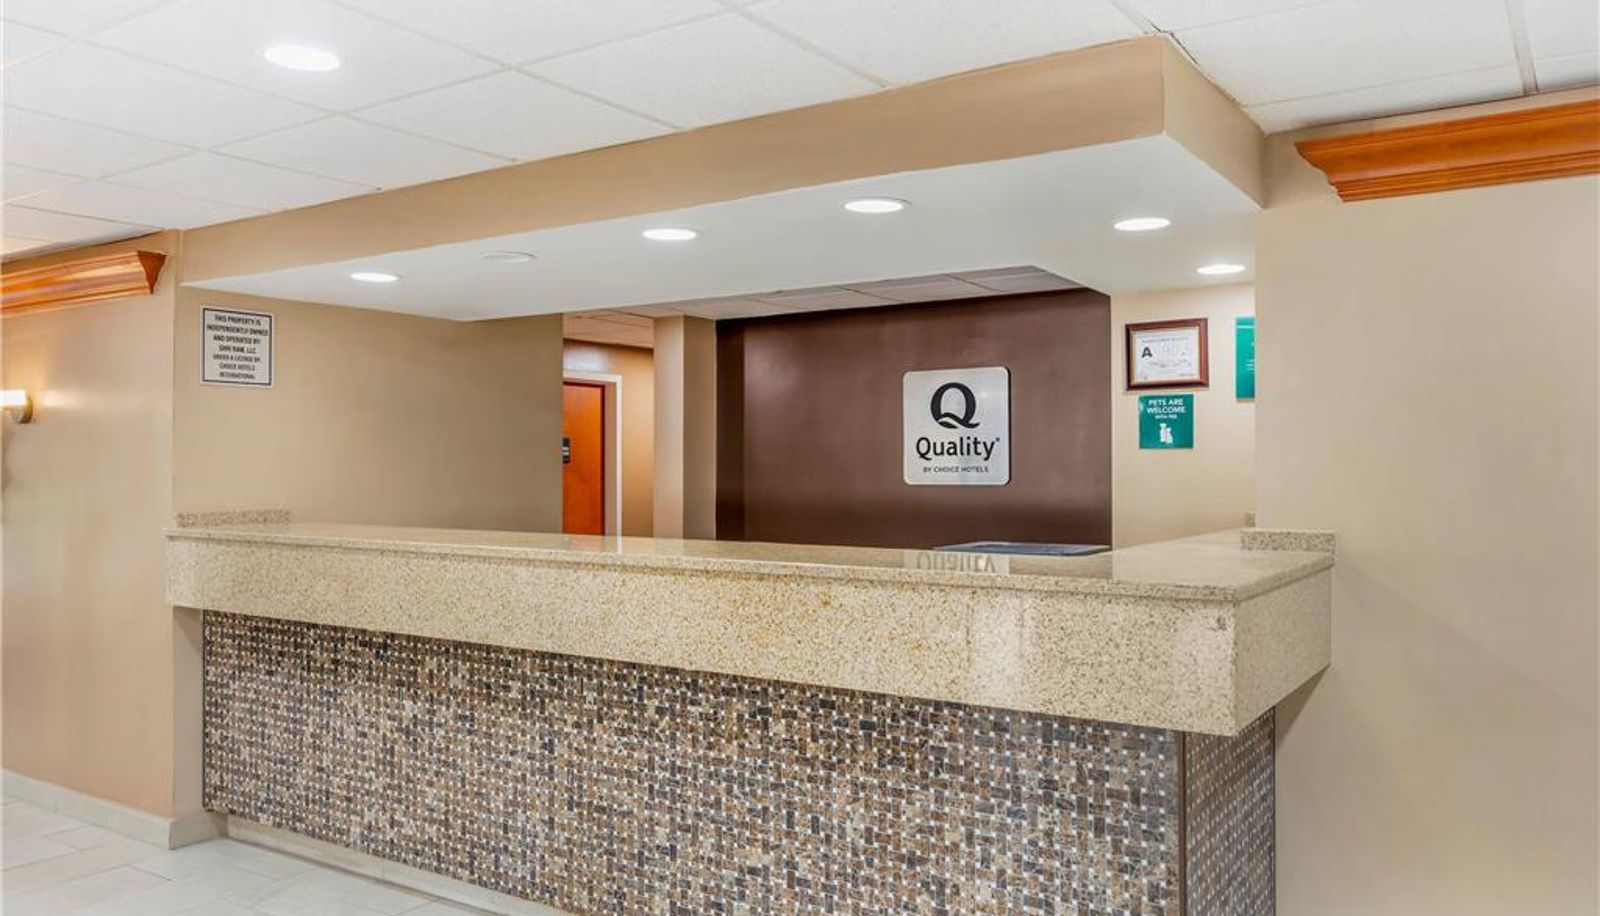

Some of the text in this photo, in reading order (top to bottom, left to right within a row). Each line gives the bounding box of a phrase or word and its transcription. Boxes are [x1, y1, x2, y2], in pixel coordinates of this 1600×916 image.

[227, 316, 255, 324] PROPERTY
[213, 334, 224, 342] AND
[1141, 346, 1153, 358] A
[930, 382, 980, 429] Q
[1168, 398, 1184, 406] ARE
[1147, 406, 1186, 414] WELCOME
[933, 465, 960, 473] CHOICE
[960, 465, 989, 473] HOTELS
